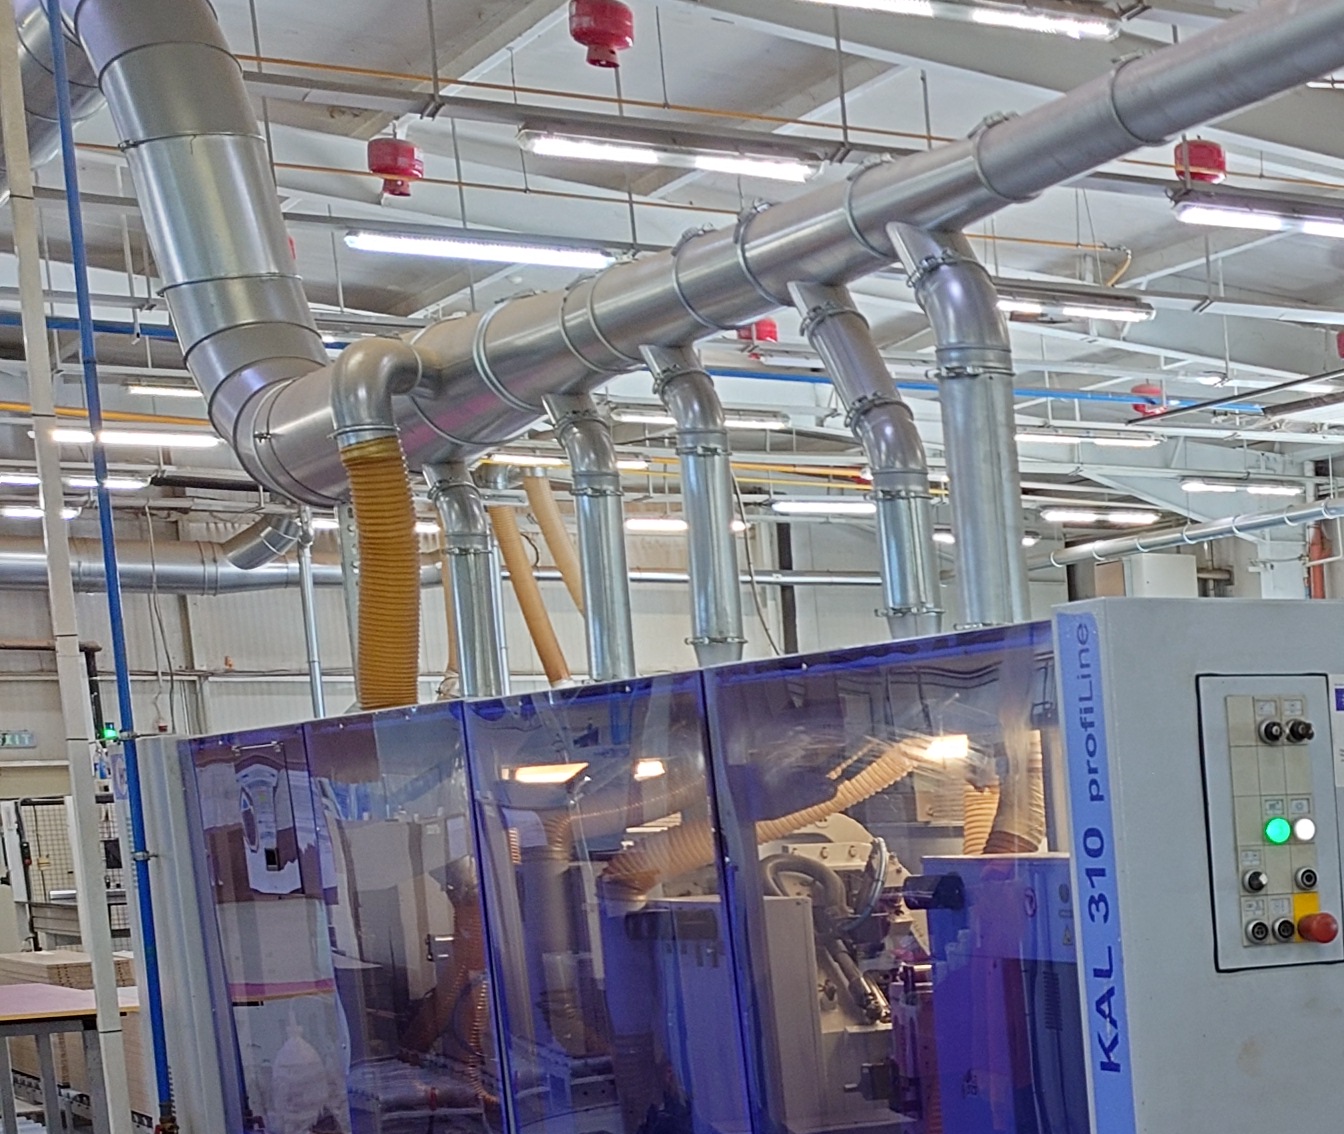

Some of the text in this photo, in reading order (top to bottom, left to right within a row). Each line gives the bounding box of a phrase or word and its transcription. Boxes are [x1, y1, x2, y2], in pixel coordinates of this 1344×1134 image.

[0, 732, 31, 746] XIT
[1076, 622, 1122, 1074] KAL 310 profiLine
